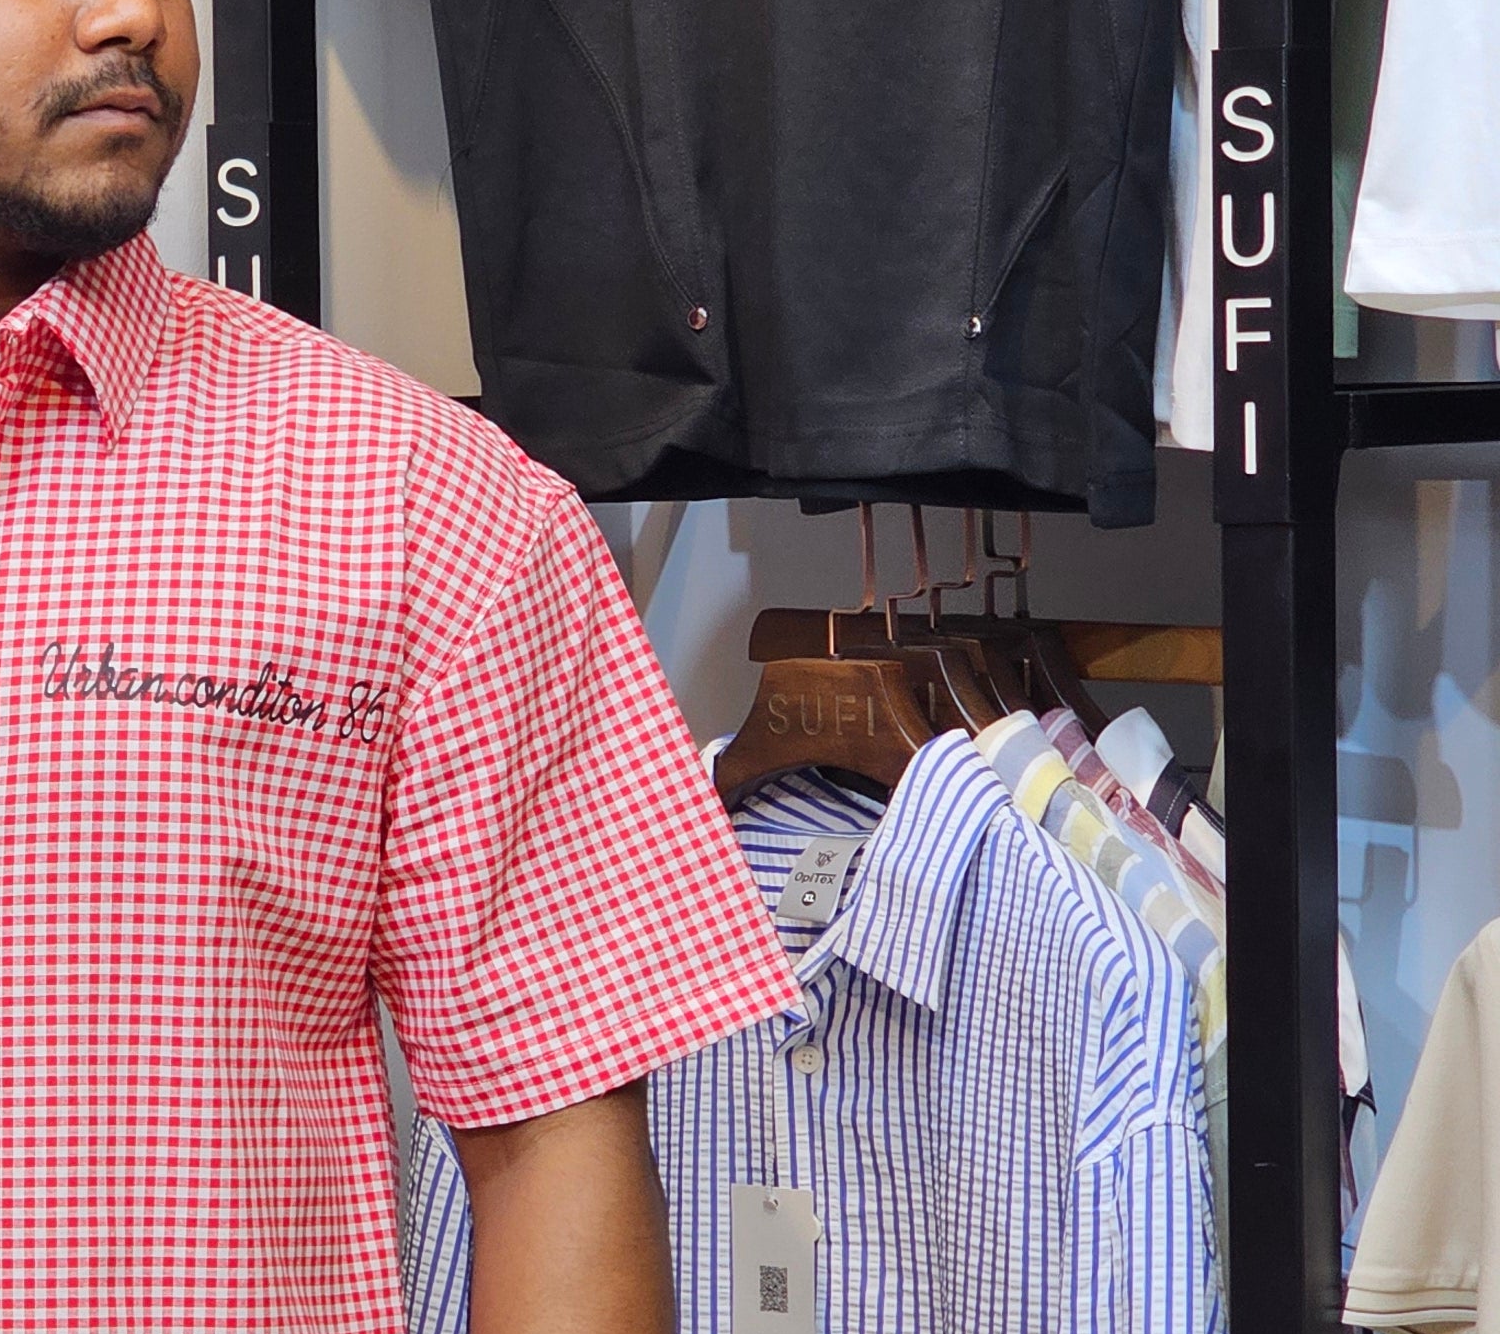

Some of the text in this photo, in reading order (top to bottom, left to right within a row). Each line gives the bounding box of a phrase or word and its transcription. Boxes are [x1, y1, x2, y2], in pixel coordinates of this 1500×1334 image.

[1220, 85, 1275, 475] SUFI
[338, 680, 389, 744] 86
[767, 693, 876, 737] SUFI
